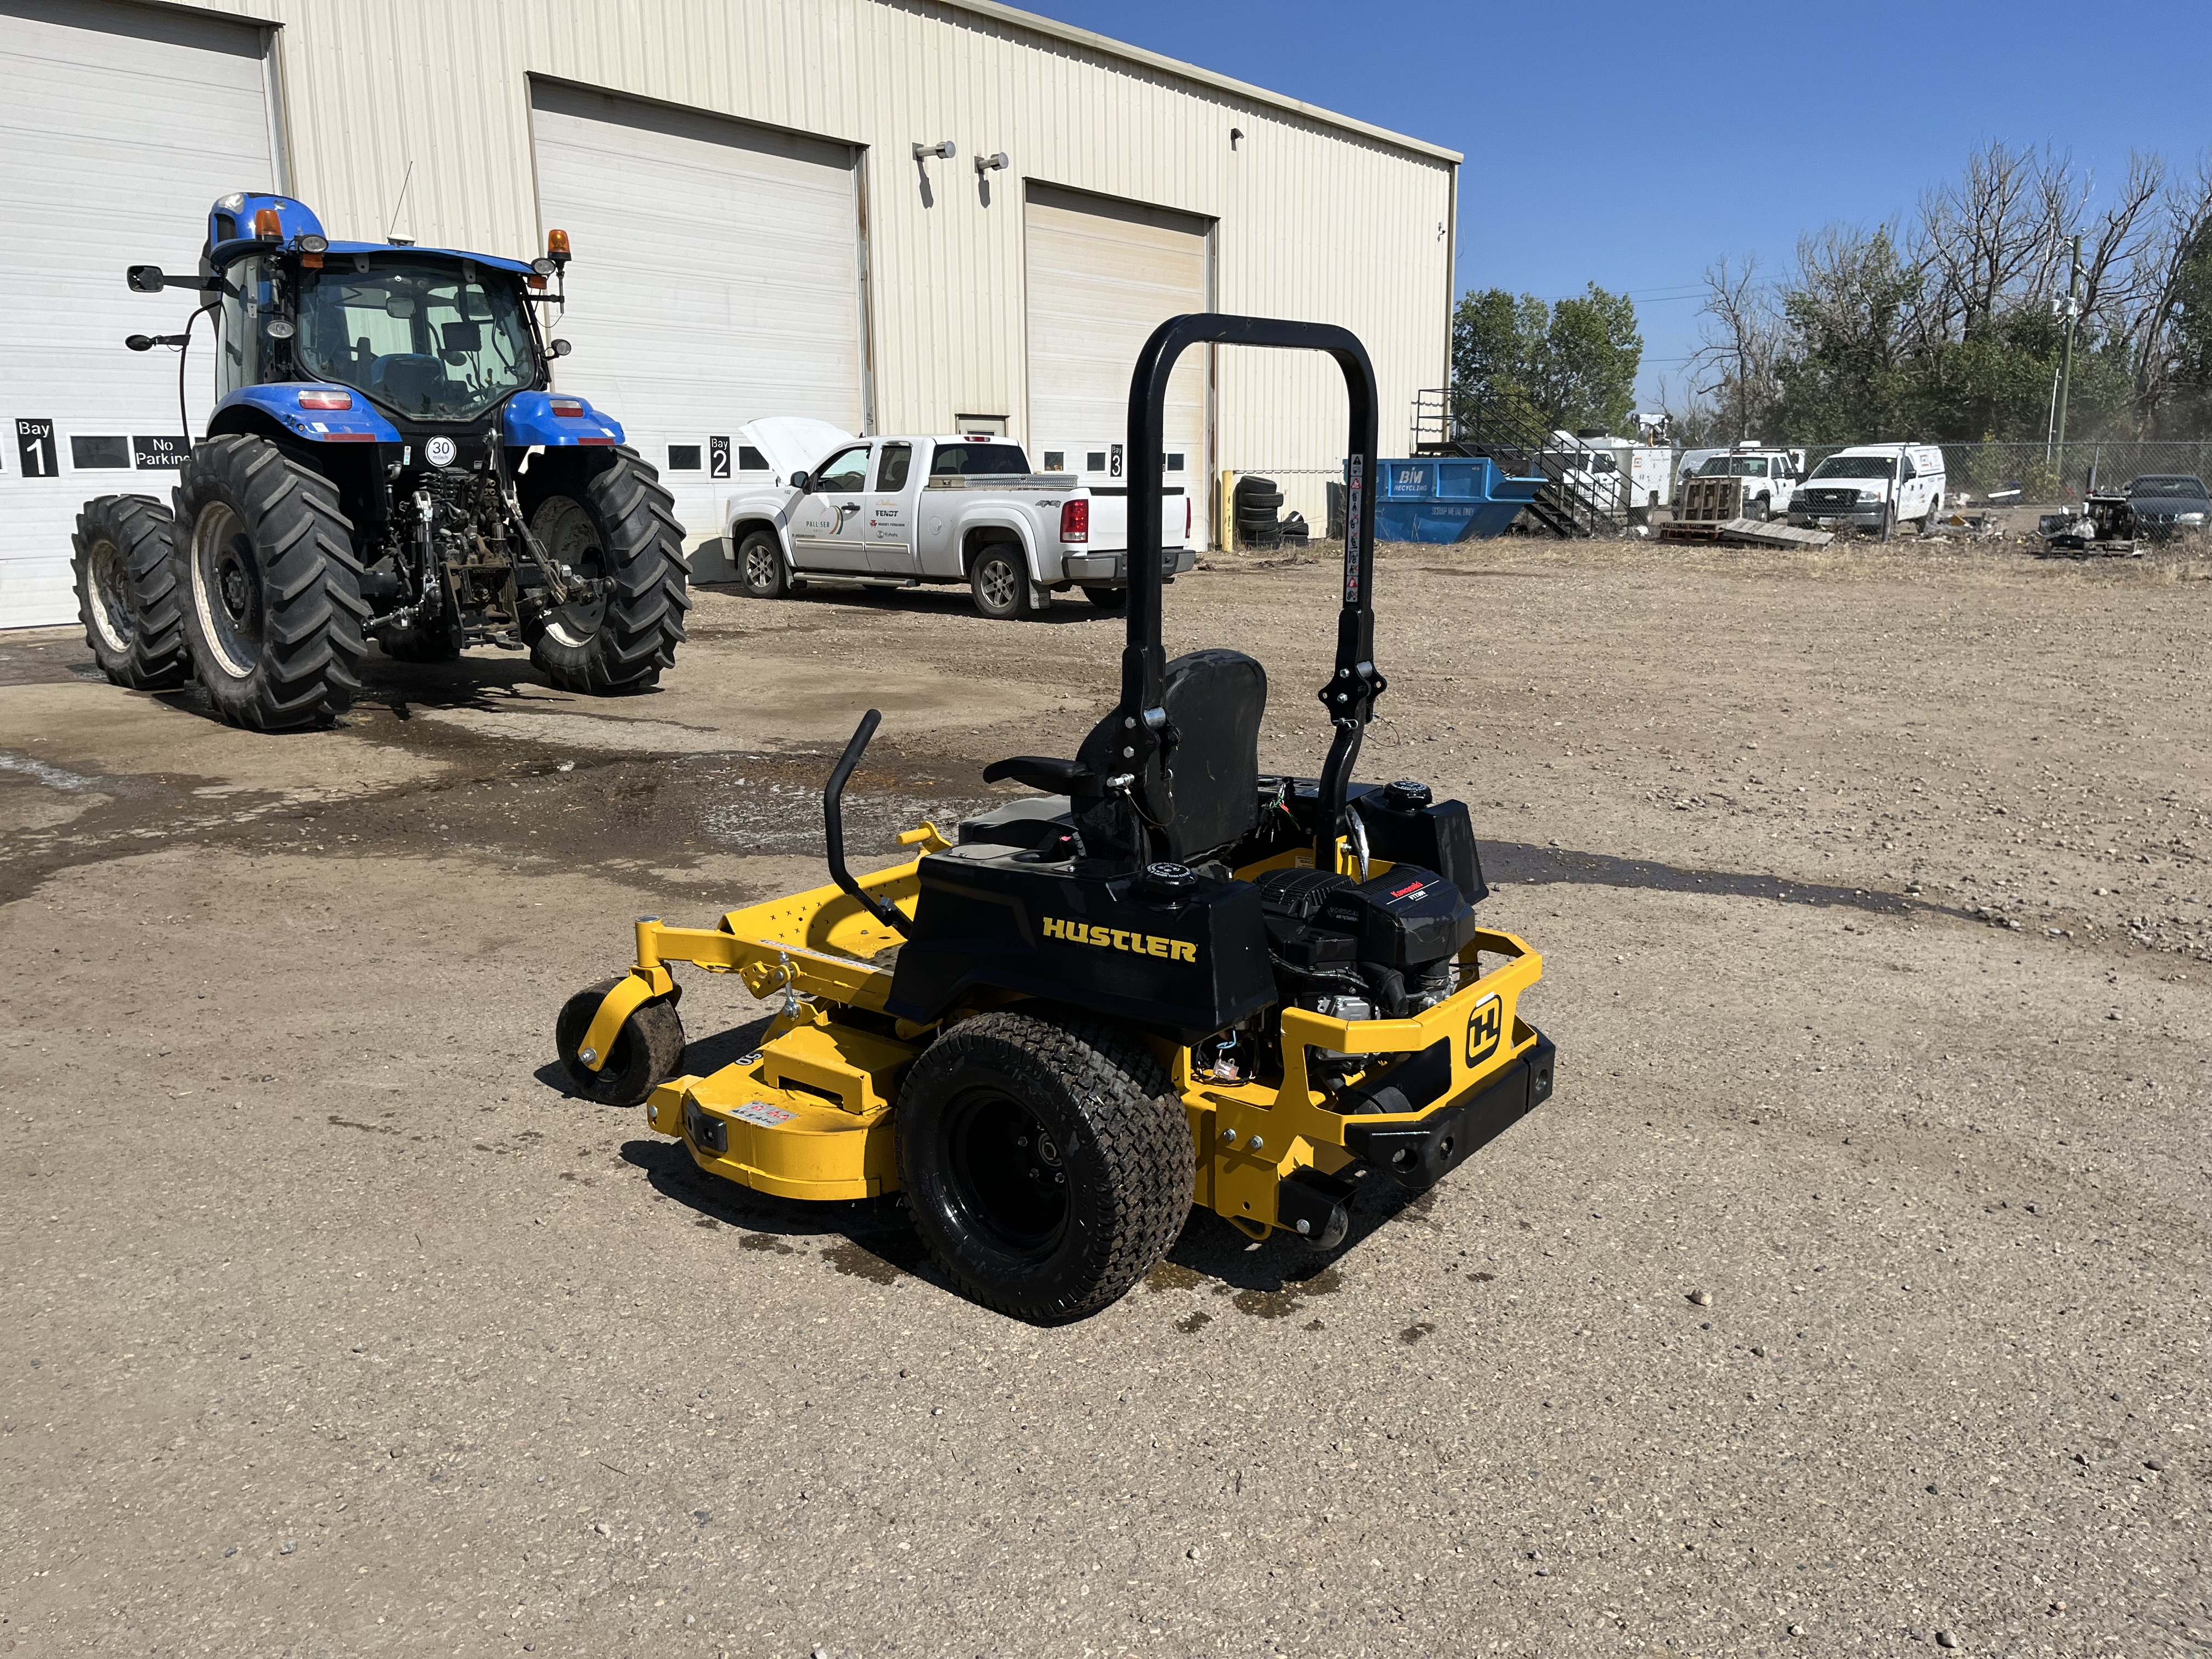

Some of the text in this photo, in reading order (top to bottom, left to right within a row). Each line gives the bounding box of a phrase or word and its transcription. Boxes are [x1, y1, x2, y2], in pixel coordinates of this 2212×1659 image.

[19, 421, 49, 437] Bay
[153, 439, 173, 451] No
[433, 442, 449, 454] 30
[712, 438, 728, 450] Bay
[1111, 445, 1121, 455] Bay
[27, 438, 46, 475] 1
[713, 450, 727, 476] 2
[1111, 455, 1120, 476] 3
[1431, 506, 1447, 515] SCRAP
[1448, 507, 1462, 516] METAL
[1390, 880, 1424, 898] Kawasaki
[1043, 917, 1197, 963] HUSTLER
